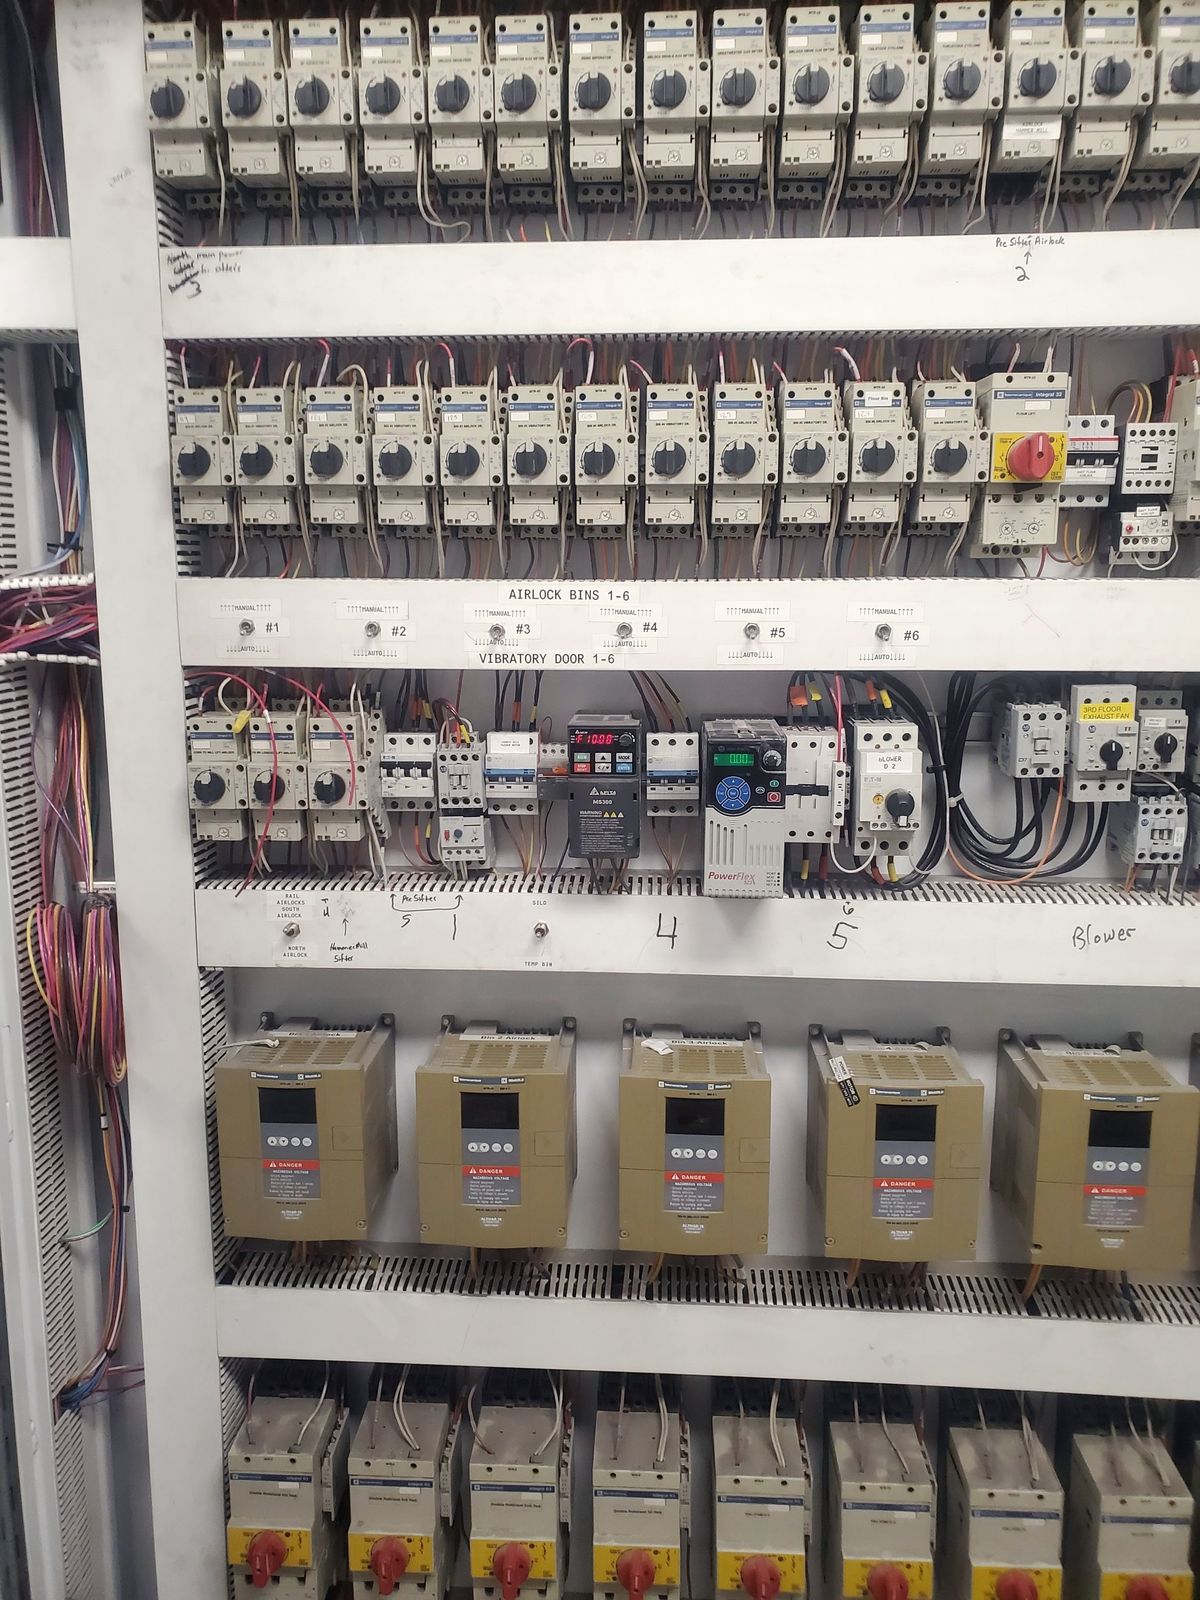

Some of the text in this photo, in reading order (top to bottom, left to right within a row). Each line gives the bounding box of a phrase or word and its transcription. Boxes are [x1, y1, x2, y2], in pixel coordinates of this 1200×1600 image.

[1034, 236, 1065, 245] Airlock
[1015, 266, 1030, 281] 2
[508, 589, 630, 601] AIRLOCK BINS 1-6
[266, 622, 279, 633] #1
[391, 626, 406, 637] #2
[516, 624, 531, 635] #3
[643, 622, 658, 632] #4
[770, 627, 786, 638] #5
[904, 630, 920, 641] #6
[479, 653, 615, 664] VIBRATORY DOOR 1-6
[842, 905, 854, 916] 6
[656, 913, 677, 950] 4
[827, 922, 858, 950] 5
[1072, 924, 1136, 950] Blower
[334, 954, 353, 963] Sifter
